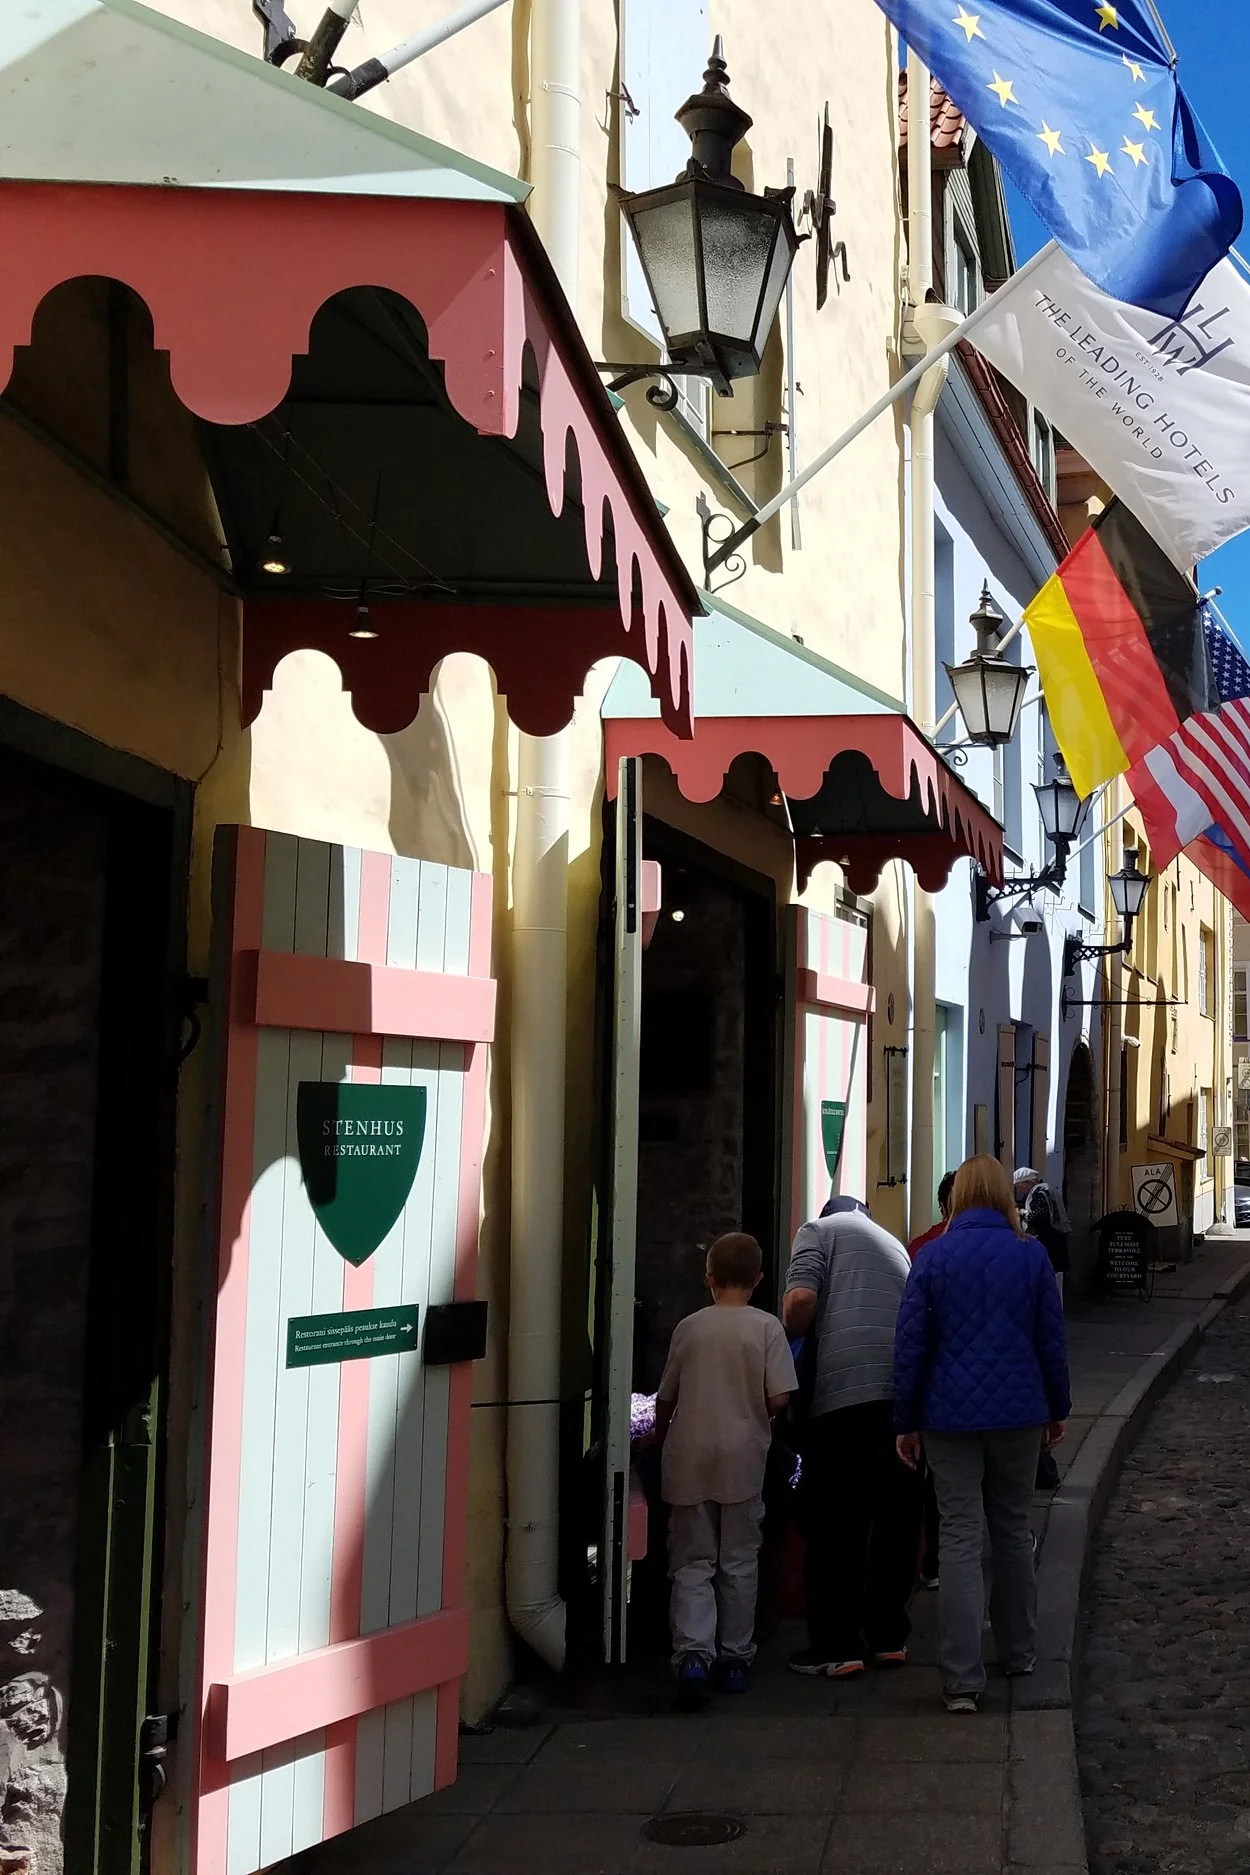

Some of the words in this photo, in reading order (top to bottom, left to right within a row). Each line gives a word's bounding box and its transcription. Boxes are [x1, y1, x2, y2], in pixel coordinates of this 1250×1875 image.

[1034, 294, 1071, 328] THE
[1069, 325, 1155, 410] LEADING
[1153, 412, 1236, 504] HOTELS
[1056, 347, 1077, 365] OF
[1078, 368, 1108, 399] THE
[1111, 402, 1163, 459] WORLD
[322, 1119, 404, 1136] STENHUS
[324, 1144, 401, 1156] RESTAURANT
[1144, 1168, 1161, 1176] ALA
[295, 1327, 326, 1339] Restorani
[327, 1324, 354, 1336] sissepääs
[379, 1318, 397, 1329] kaudu
[294, 1343, 322, 1352] Restaurant
[322, 1340, 344, 1349] entrance
[344, 1337, 364, 1347] through
[364, 1336, 372, 1344] the
[385, 1333, 397, 1341] door
